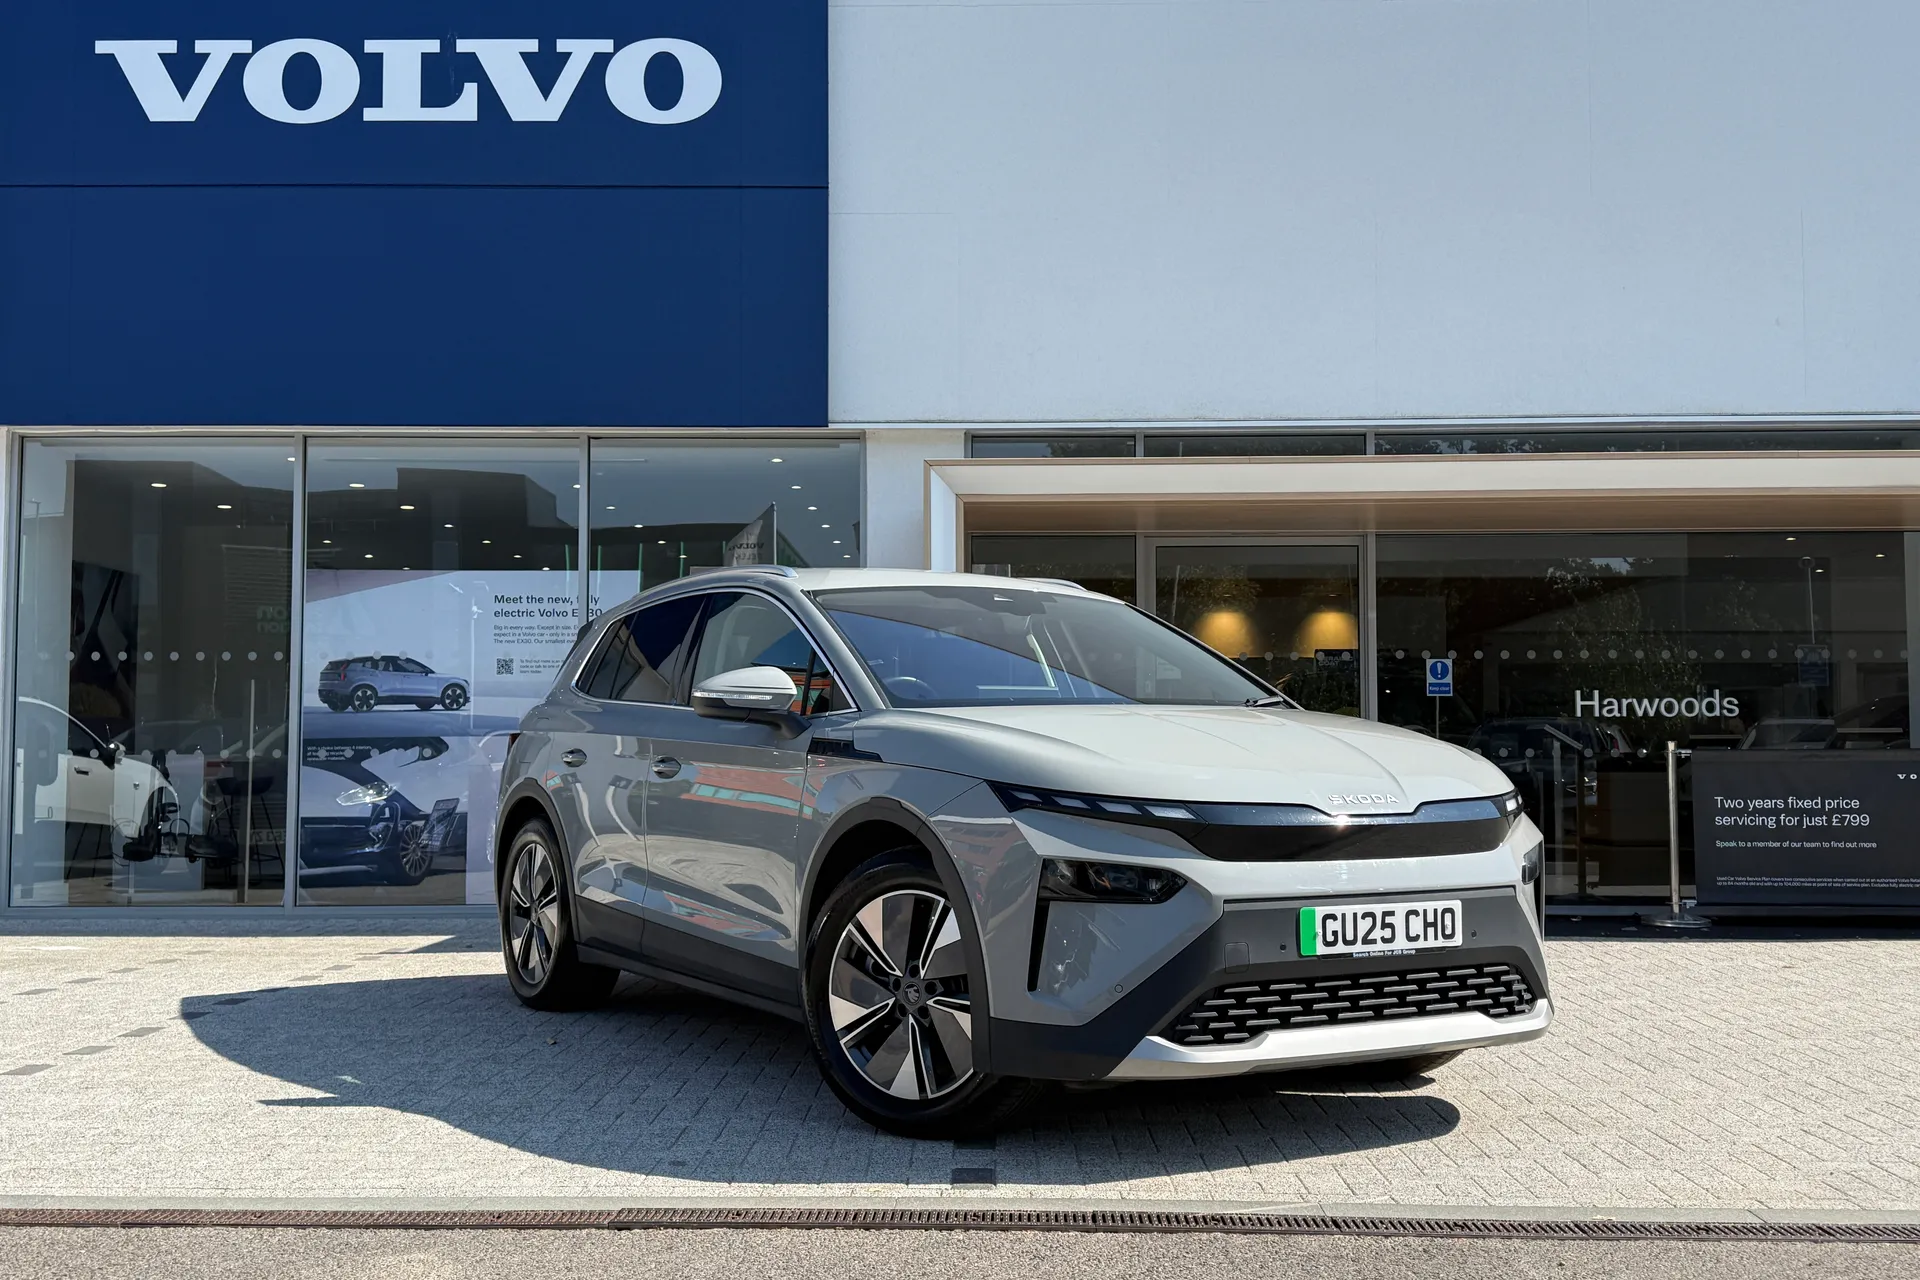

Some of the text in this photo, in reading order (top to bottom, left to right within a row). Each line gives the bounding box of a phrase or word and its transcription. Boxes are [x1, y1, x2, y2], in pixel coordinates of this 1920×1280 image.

[95, 37, 722, 125] VOLVO
[494, 594, 600, 606] Meet the new, fly
[494, 608, 602, 618] electric Volvo E30
[537, 624, 554, 632] Except
[1574, 689, 1739, 718] Harwoods
[1328, 793, 1399, 805] SKODA
[1713, 796, 1860, 811] Two years fixed price
[1714, 814, 1870, 829] servicing for just £799
[1716, 840, 1738, 848] Speak
[1752, 840, 1781, 848] member
[1782, 840, 1790, 848] of
[1831, 840, 1845, 848] find
[1321, 907, 1456, 947] GU25 CHO
